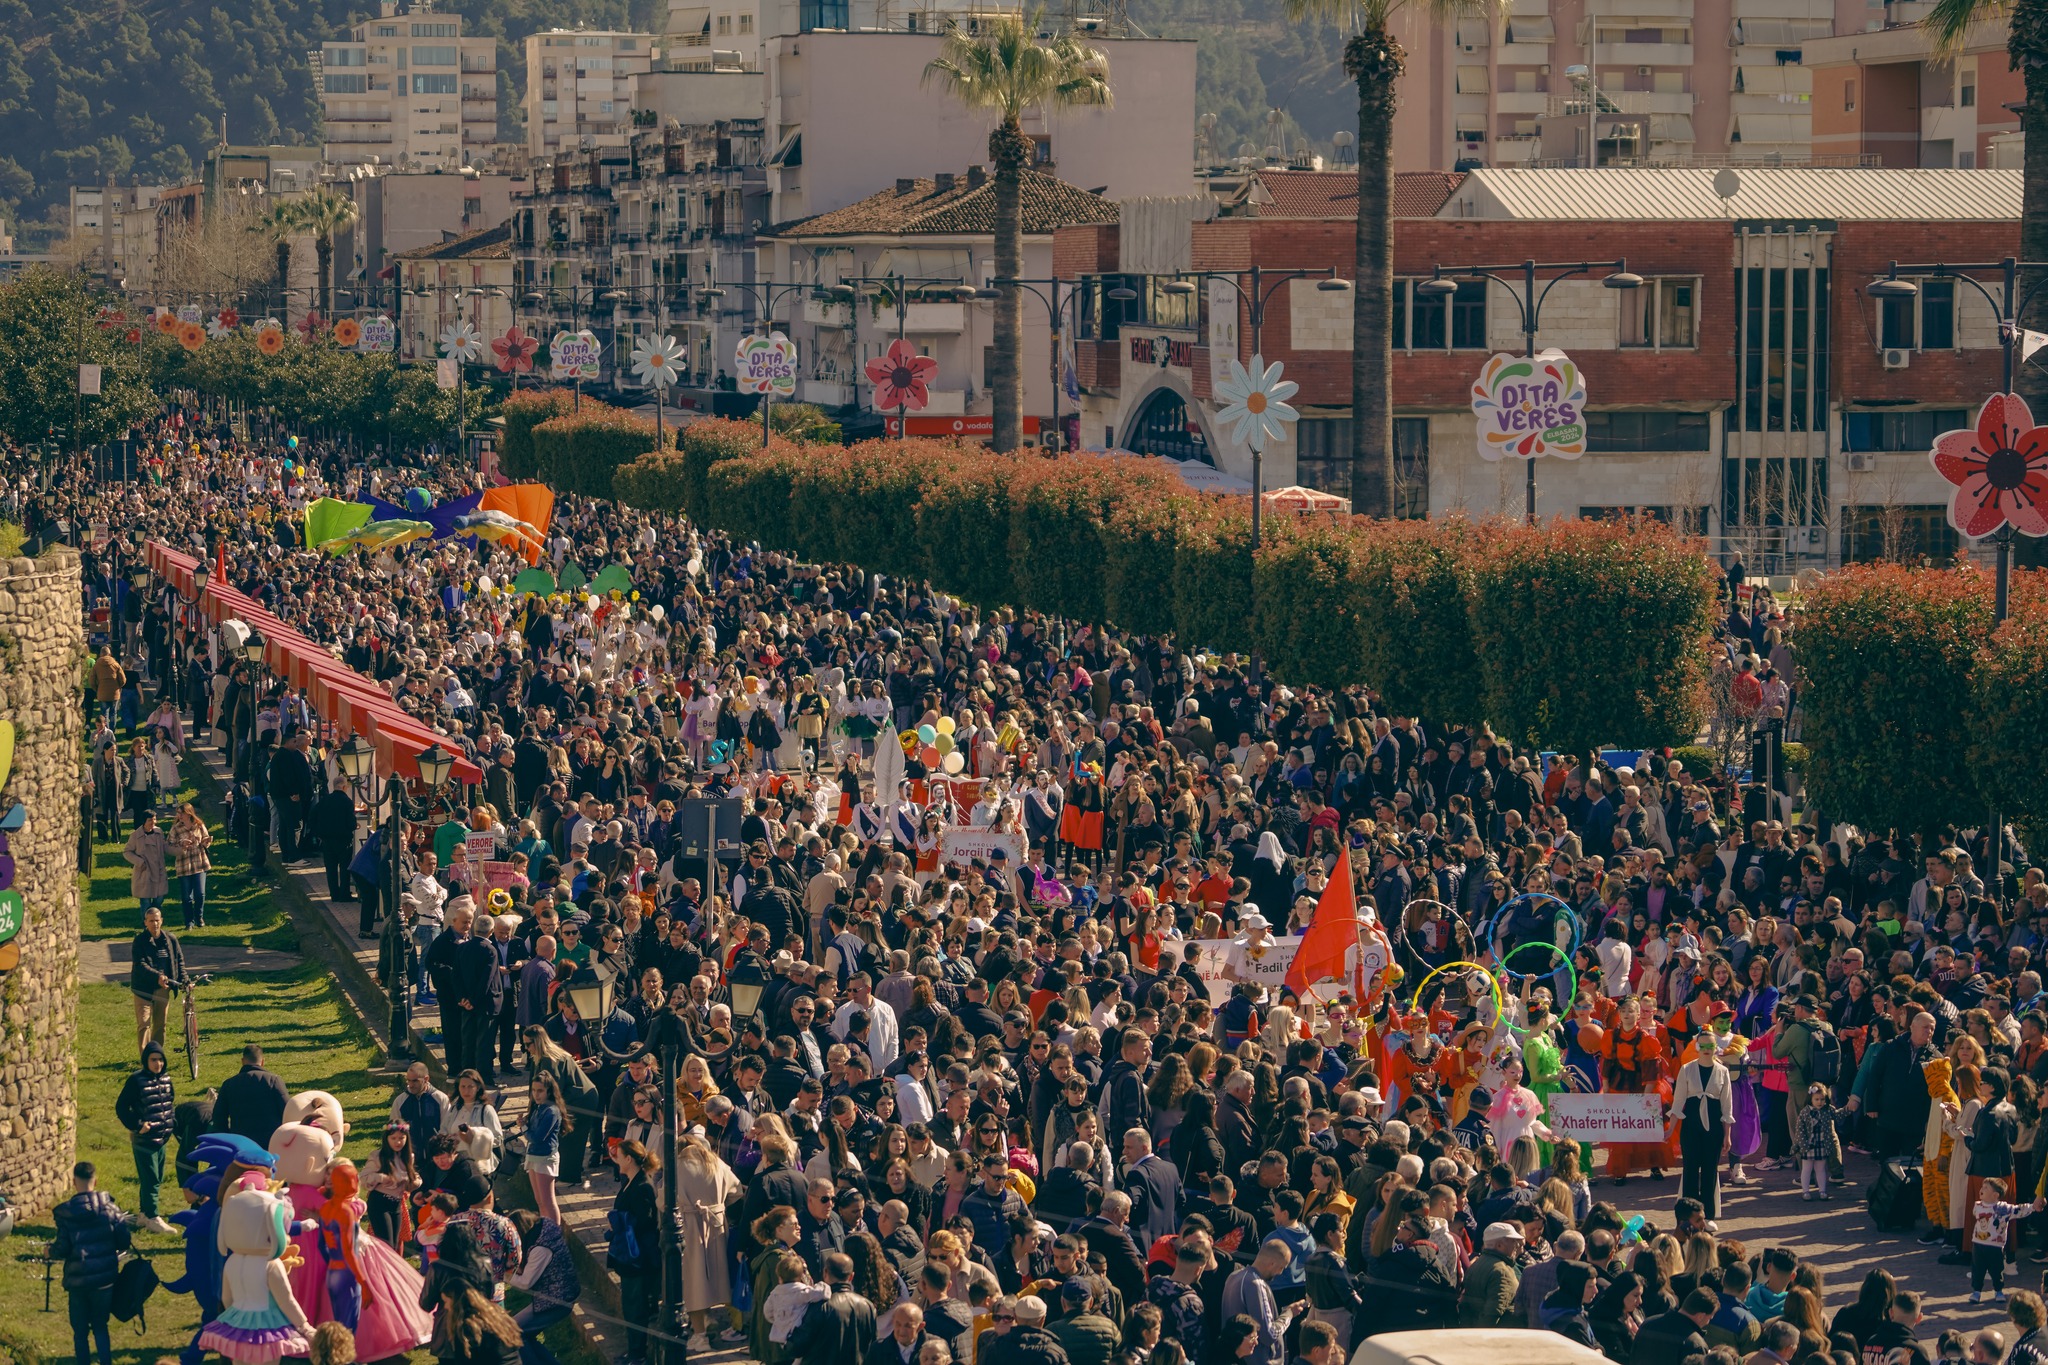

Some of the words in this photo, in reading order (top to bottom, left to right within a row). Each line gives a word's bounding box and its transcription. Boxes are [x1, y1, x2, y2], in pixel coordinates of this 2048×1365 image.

[367, 326, 386, 334] DITA
[564, 344, 589, 355] DITA
[561, 353, 596, 365] VERËS
[752, 351, 783, 366] DITA
[748, 363, 791, 378] VERËS
[1502, 381, 1559, 409] DITA
[1496, 403, 1577, 432] VERËS
[1547, 426, 1578, 439] ELBASAN
[1560, 433, 1580, 442] 2024
[467, 837, 493, 849] VERORE
[1255, 962, 1283, 973] Fadil
[1561, 1115, 1607, 1129] Xhaferr
[1611, 1115, 1656, 1129] Hakani
